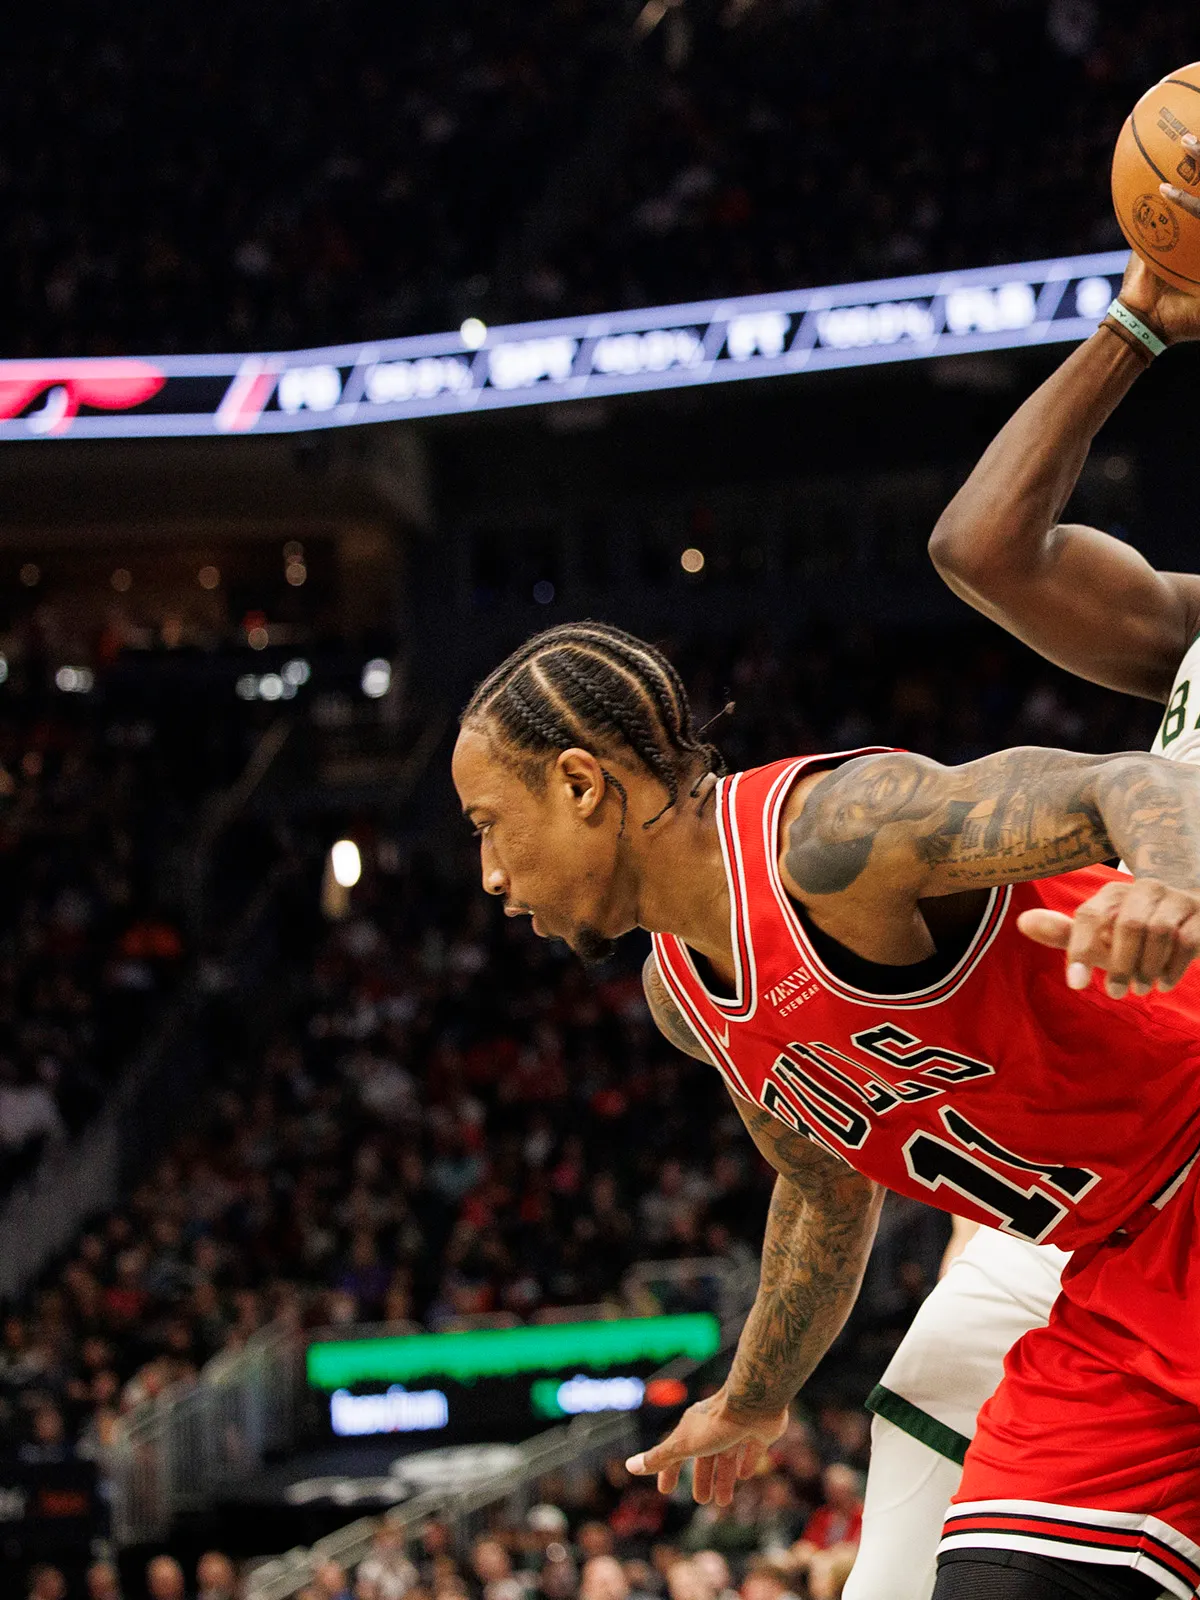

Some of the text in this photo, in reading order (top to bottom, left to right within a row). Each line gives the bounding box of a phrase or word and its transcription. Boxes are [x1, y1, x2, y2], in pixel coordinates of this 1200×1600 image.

[779, 983, 820, 1017] EYEWEAR
[760, 1021, 996, 1166] BULLS
[902, 1104, 1102, 1246] 11
